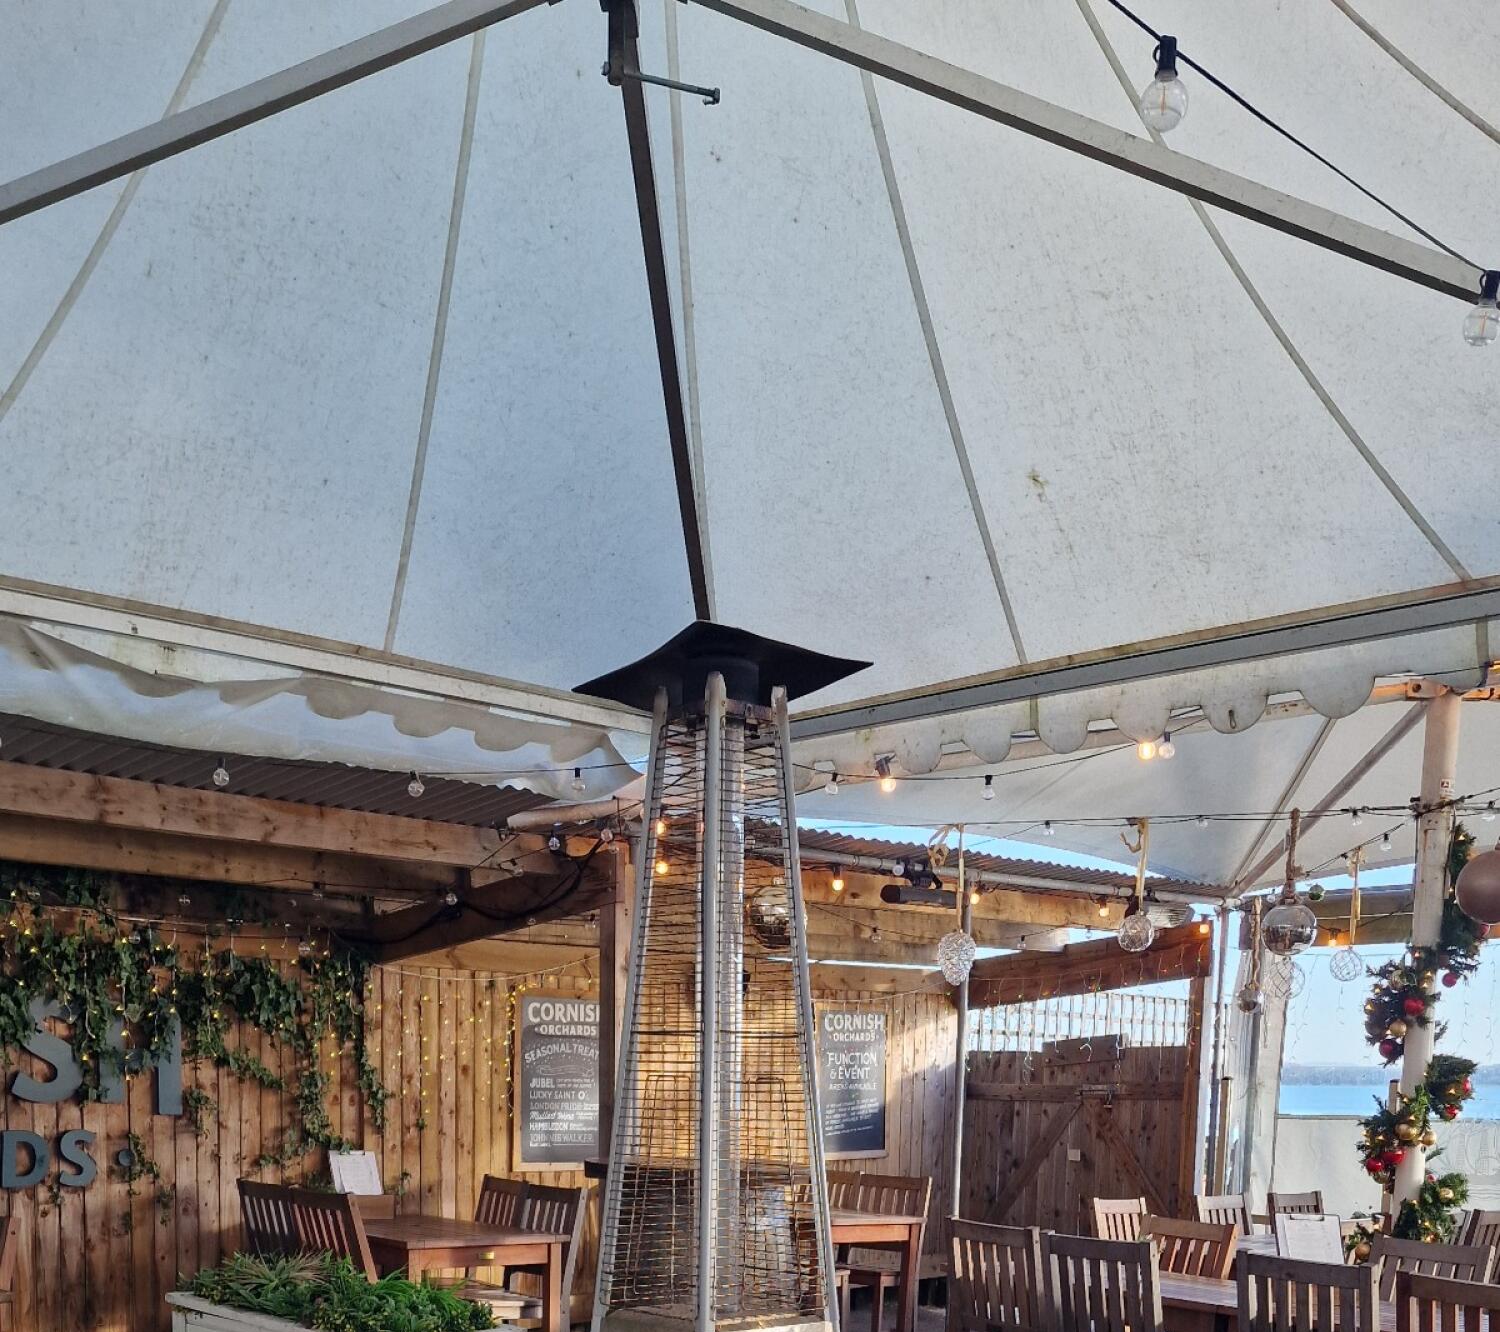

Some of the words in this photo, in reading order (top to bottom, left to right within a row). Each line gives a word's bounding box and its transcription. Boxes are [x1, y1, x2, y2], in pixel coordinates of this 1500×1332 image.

[824, 1013, 885, 1031] CORNISH
[540, 1024, 597, 1036] ORCHARDS
[833, 1031, 876, 1041] ORCHARDS
[525, 1043, 572, 1063] SEASONAL
[827, 1052, 878, 1066] FUNCTION
[838, 1066, 871, 1080] EVENT
[530, 1078, 556, 1088] JUBEL
[529, 1090, 552, 1100] LUCKY
[553, 1090, 576, 1100] SAINT
[529, 1102, 560, 1110] LONDON
[561, 1133, 594, 1143] WALKER
